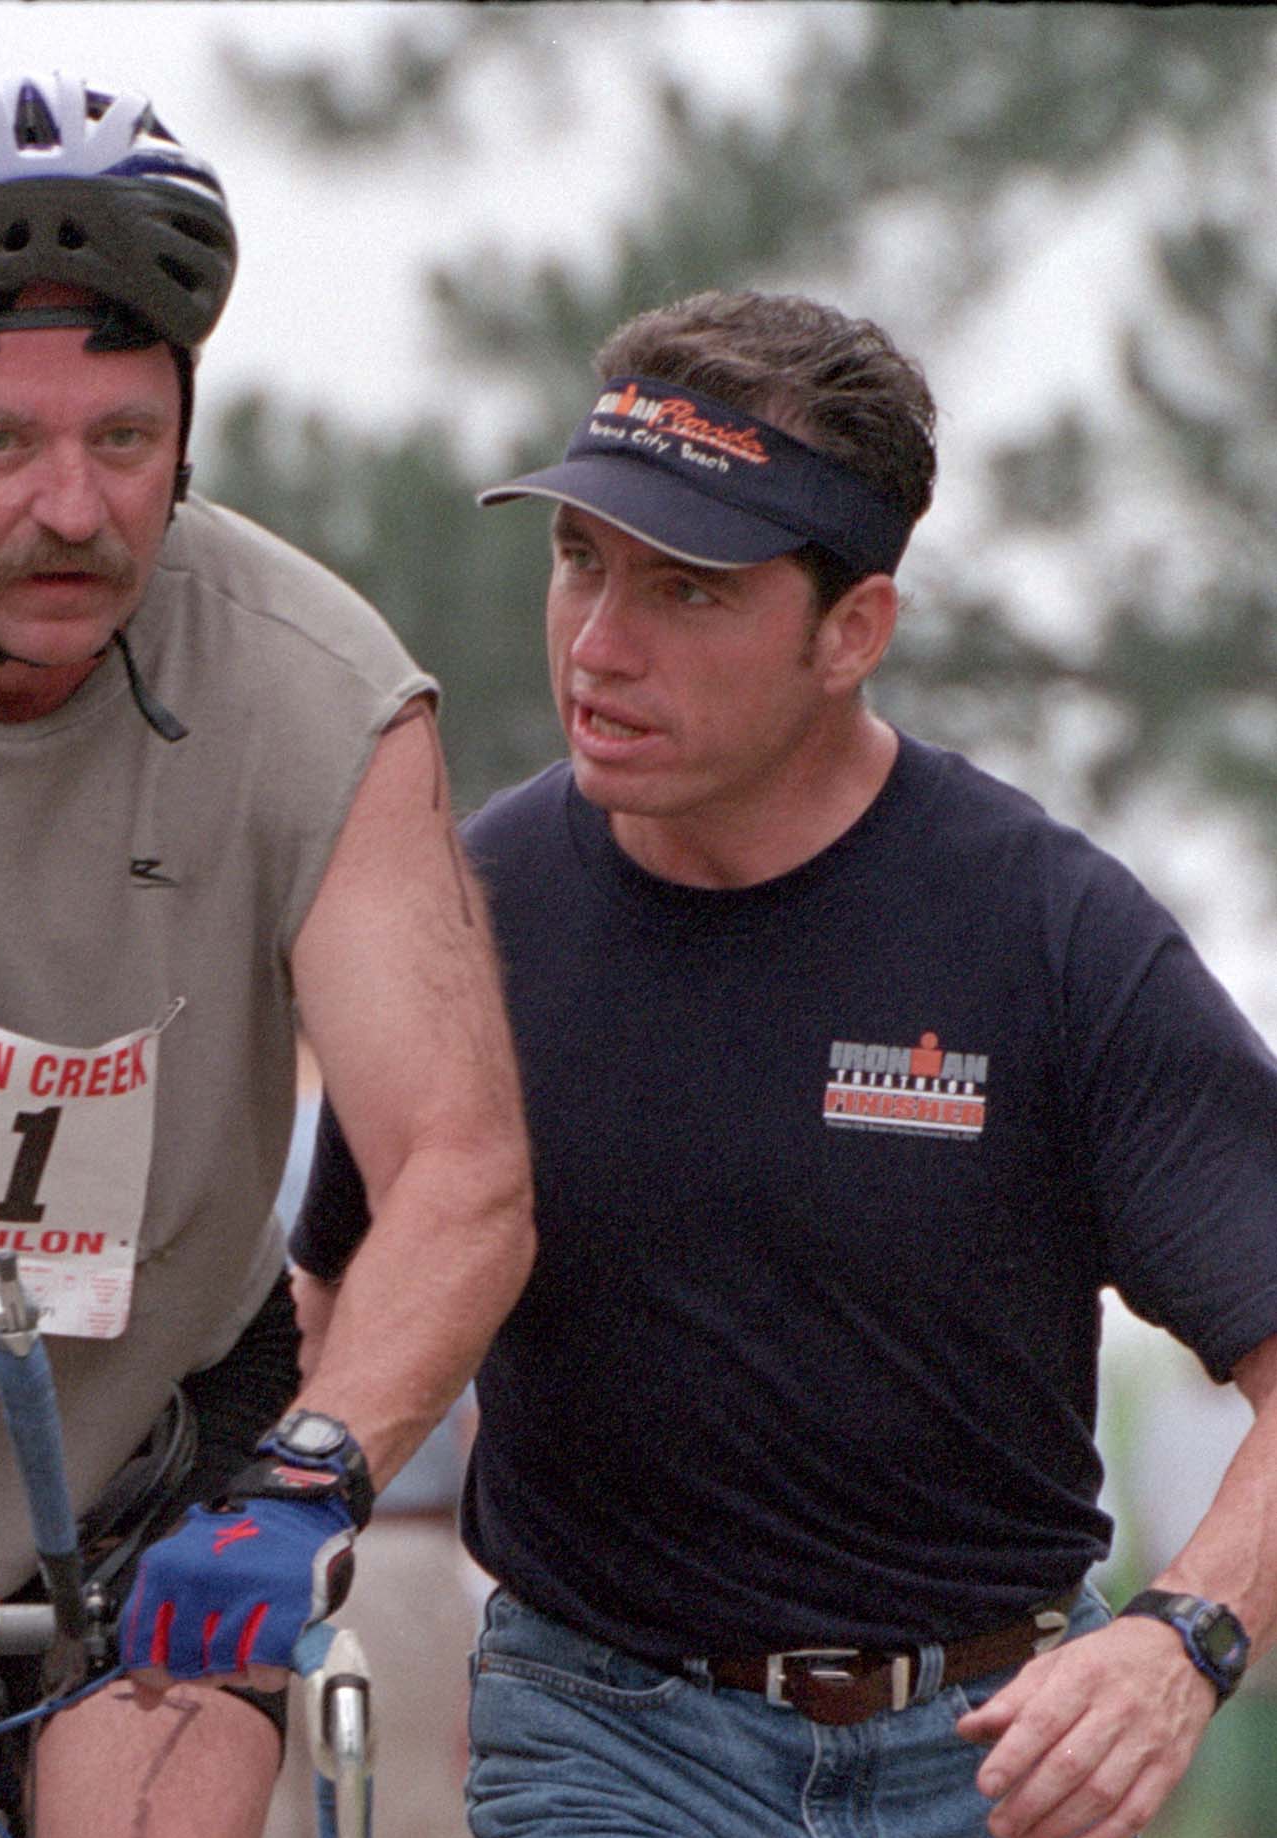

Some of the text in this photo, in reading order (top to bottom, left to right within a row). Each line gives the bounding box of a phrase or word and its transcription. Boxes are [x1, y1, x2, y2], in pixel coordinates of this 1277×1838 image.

[631, 428, 672, 453] City
[29, 1037, 147, 1098] CREEK
[829, 1032, 989, 1083] IRONMAN
[825, 1089, 986, 1128] FINISHER
